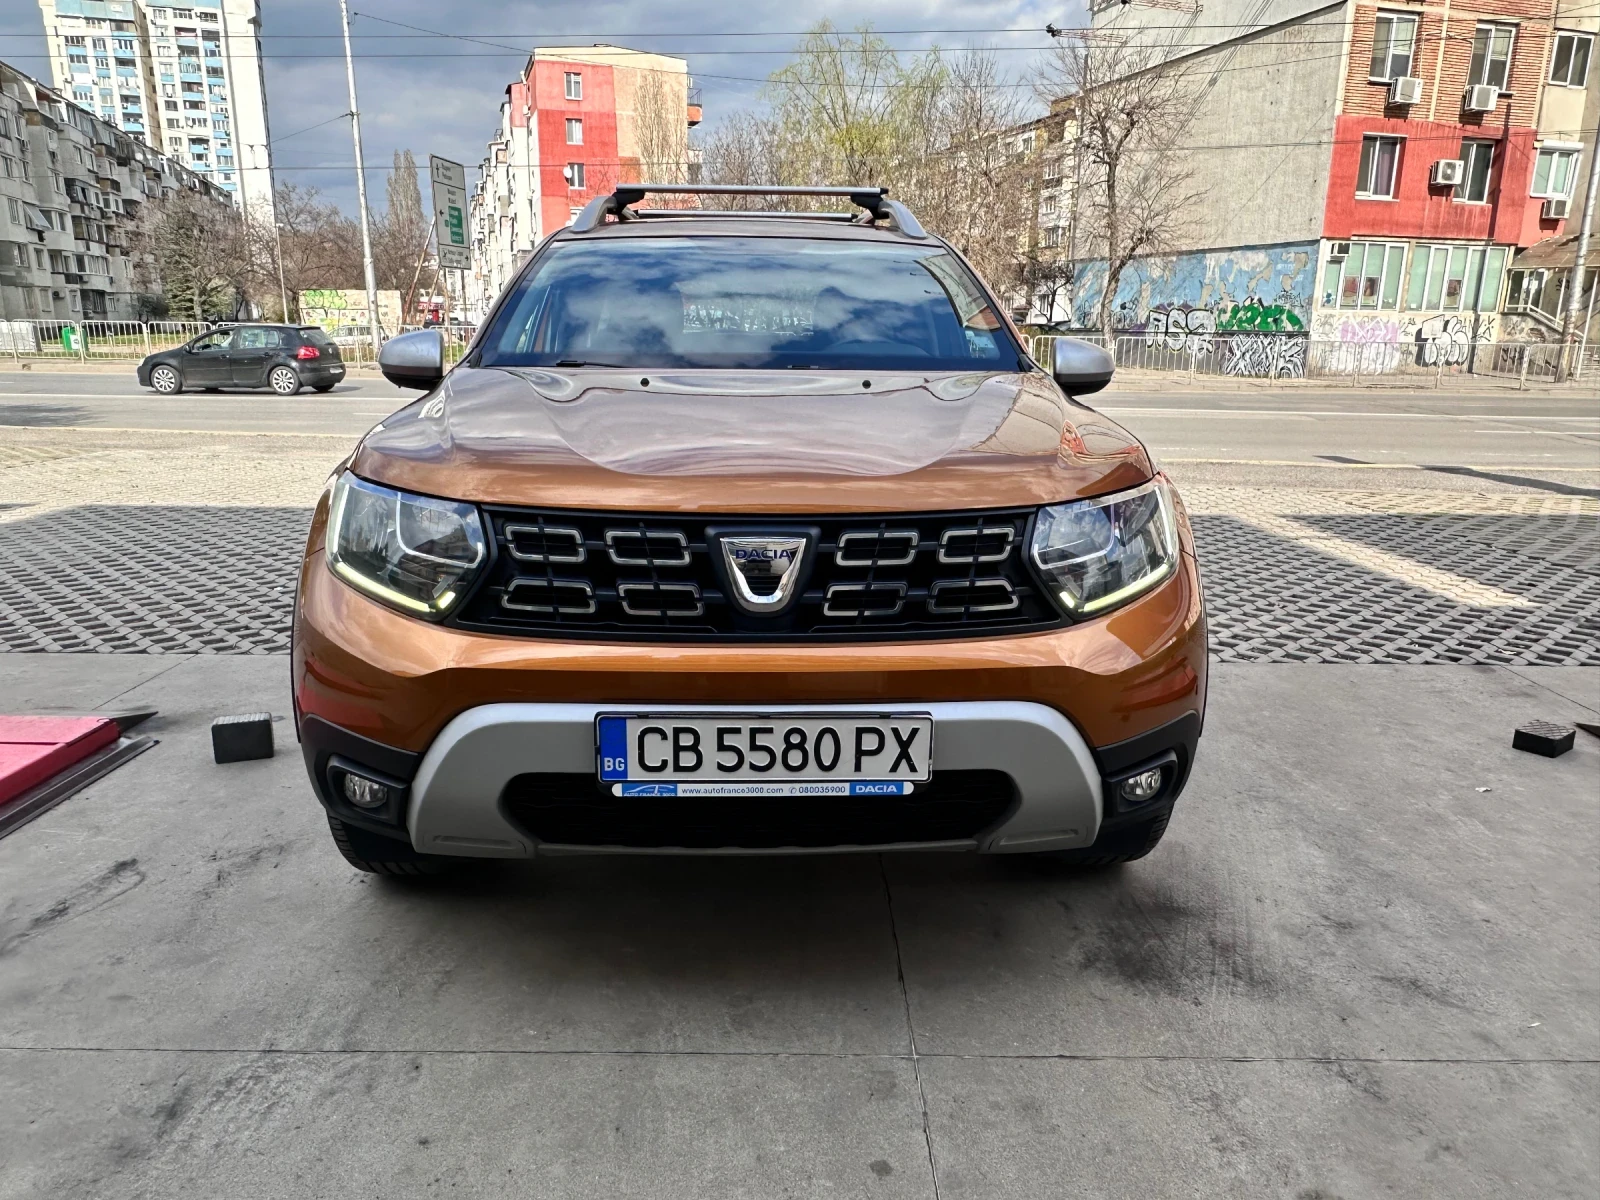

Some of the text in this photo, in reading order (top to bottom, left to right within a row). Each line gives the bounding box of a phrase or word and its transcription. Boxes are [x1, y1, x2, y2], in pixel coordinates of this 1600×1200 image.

[735, 549, 792, 560] DACIA
[637, 726, 921, 773] CB 5580 PX
[603, 757, 625, 771] BG
[855, 784, 898, 793] DACIA
